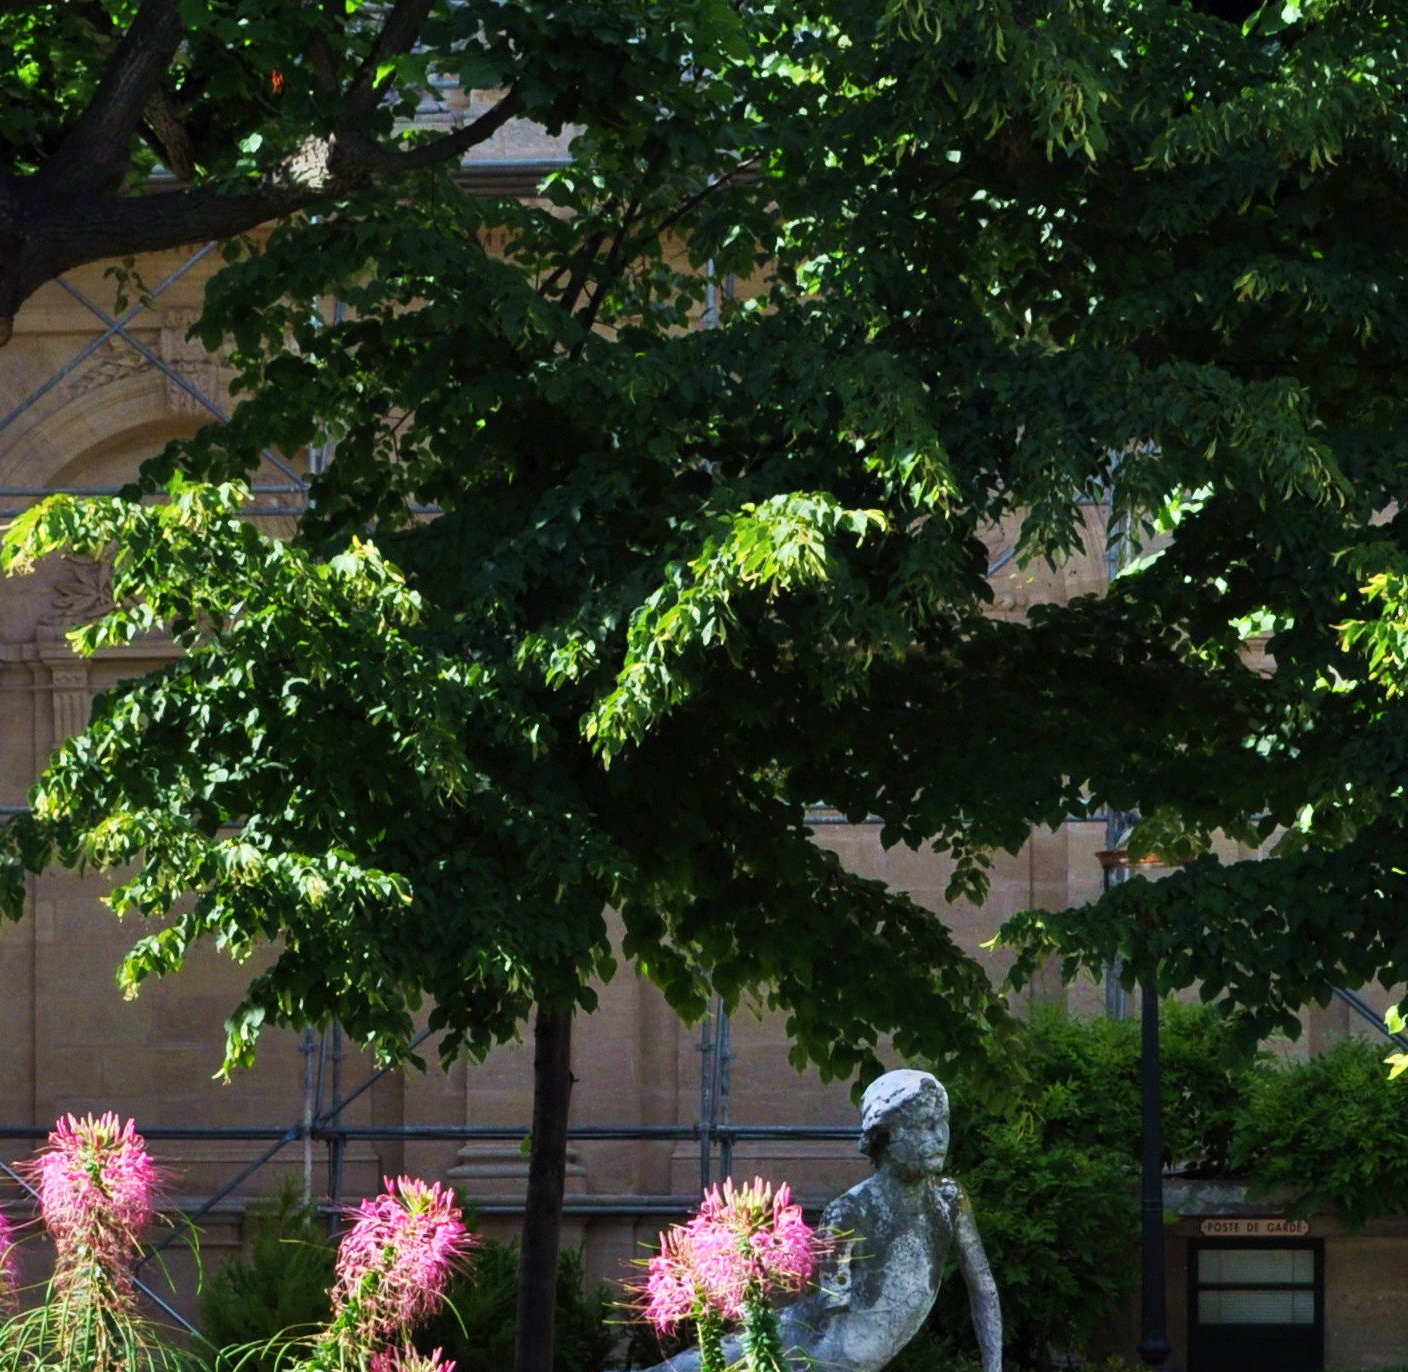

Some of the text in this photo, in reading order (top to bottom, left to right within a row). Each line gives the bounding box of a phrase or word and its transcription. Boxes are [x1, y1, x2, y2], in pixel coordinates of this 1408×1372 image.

[1207, 1222, 1302, 1232] POSTE DE GARDE
